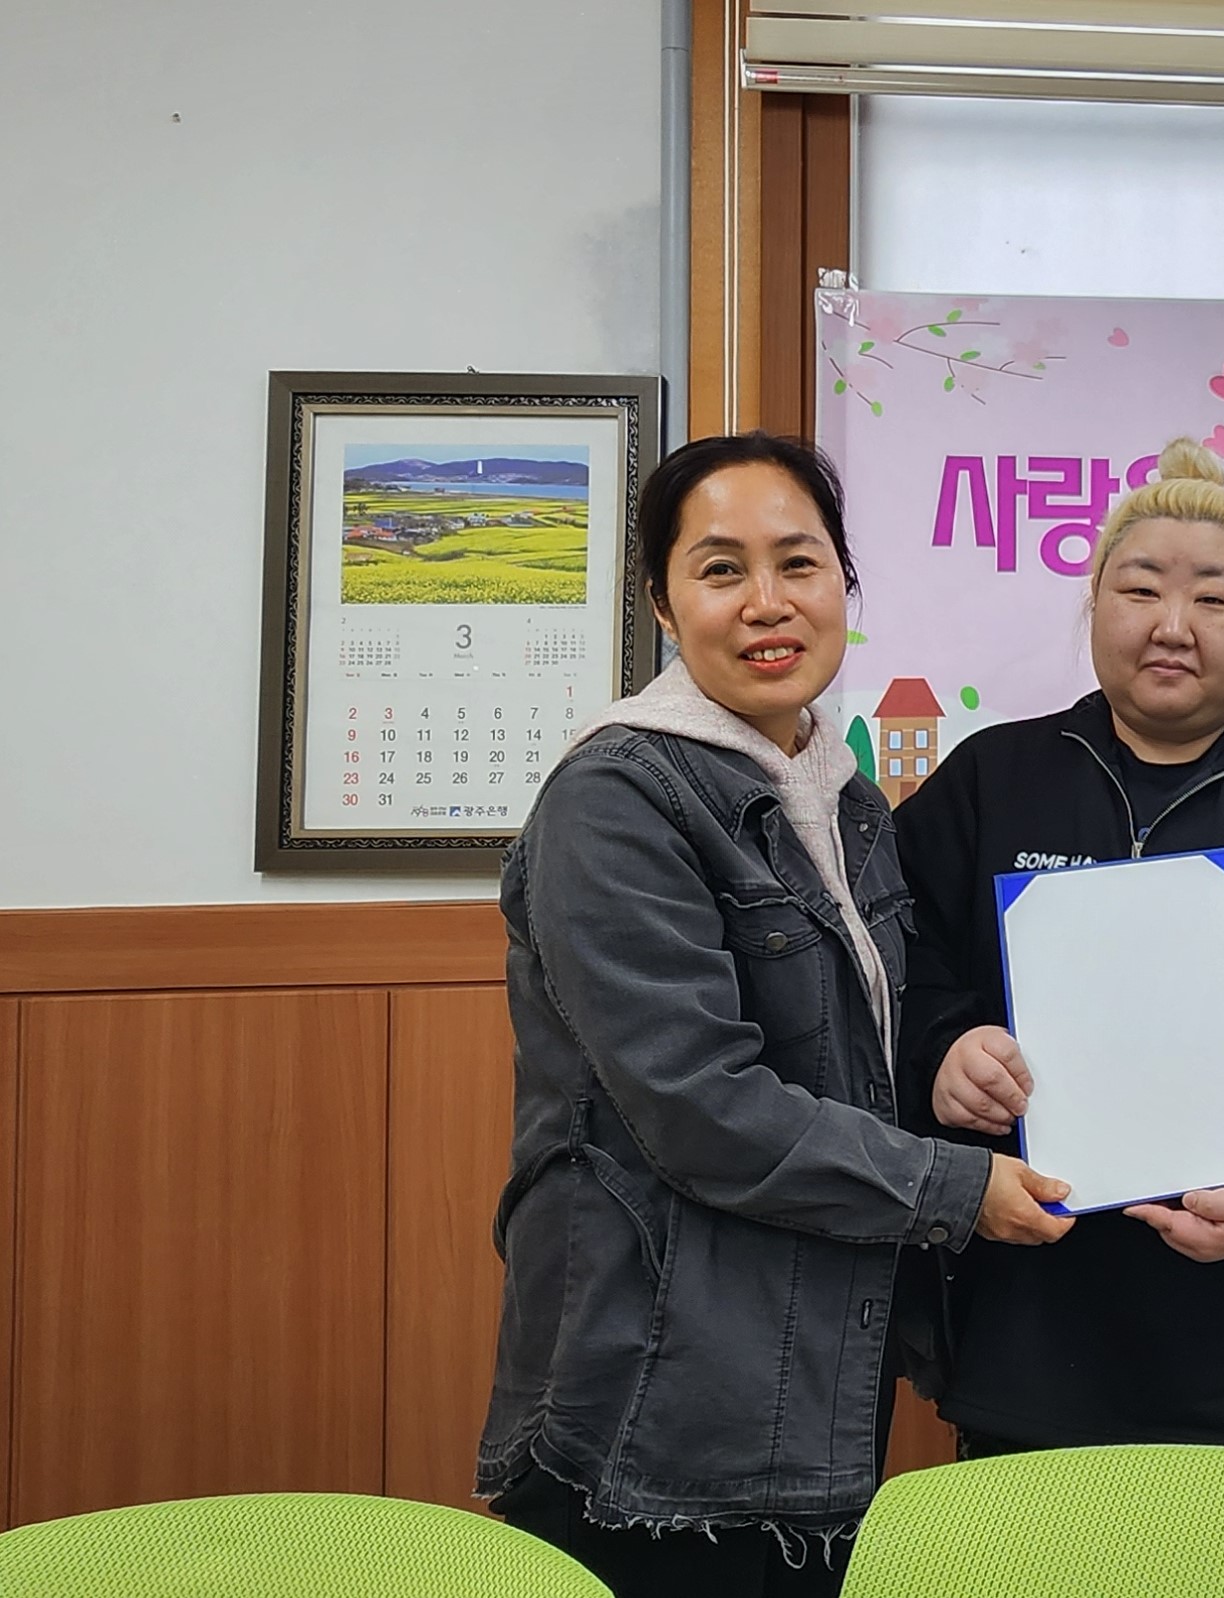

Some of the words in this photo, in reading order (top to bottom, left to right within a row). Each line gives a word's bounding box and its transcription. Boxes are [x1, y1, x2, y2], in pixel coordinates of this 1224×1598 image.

[931, 454, 1160, 577] 사랑
[455, 624, 472, 649] 3
[567, 686, 572, 697] 1
[349, 707, 357, 719] 2
[384, 707, 393, 719] 3
[421, 708, 429, 719] 4
[457, 707, 465, 719] 5
[494, 707, 502, 719] 6
[531, 707, 538, 719] 7
[565, 707, 574, 719] 8
[348, 729, 356, 741] 9
[380, 729, 396, 741] 10
[417, 729, 430, 741] 11
[454, 729, 469, 741] 12
[490, 729, 505, 741] 13
[527, 729, 541, 741] 14
[344, 751, 359, 763] 16
[380, 751, 395, 763] 17
[417, 751, 432, 763] 18
[453, 751, 468, 762] 19
[489, 751, 505, 762] 20
[526, 751, 539, 762] 21
[343, 772, 359, 784] 23
[379, 772, 394, 784] 24
[416, 772, 431, 784] 25
[453, 772, 468, 784] 26
[489, 772, 504, 784] 27
[525, 772, 541, 783] 28
[342, 794, 358, 806] 30
[378, 793, 392, 806] 31
[463, 805, 508, 817] 광주은행
[1014, 852, 1068, 870] SOME
